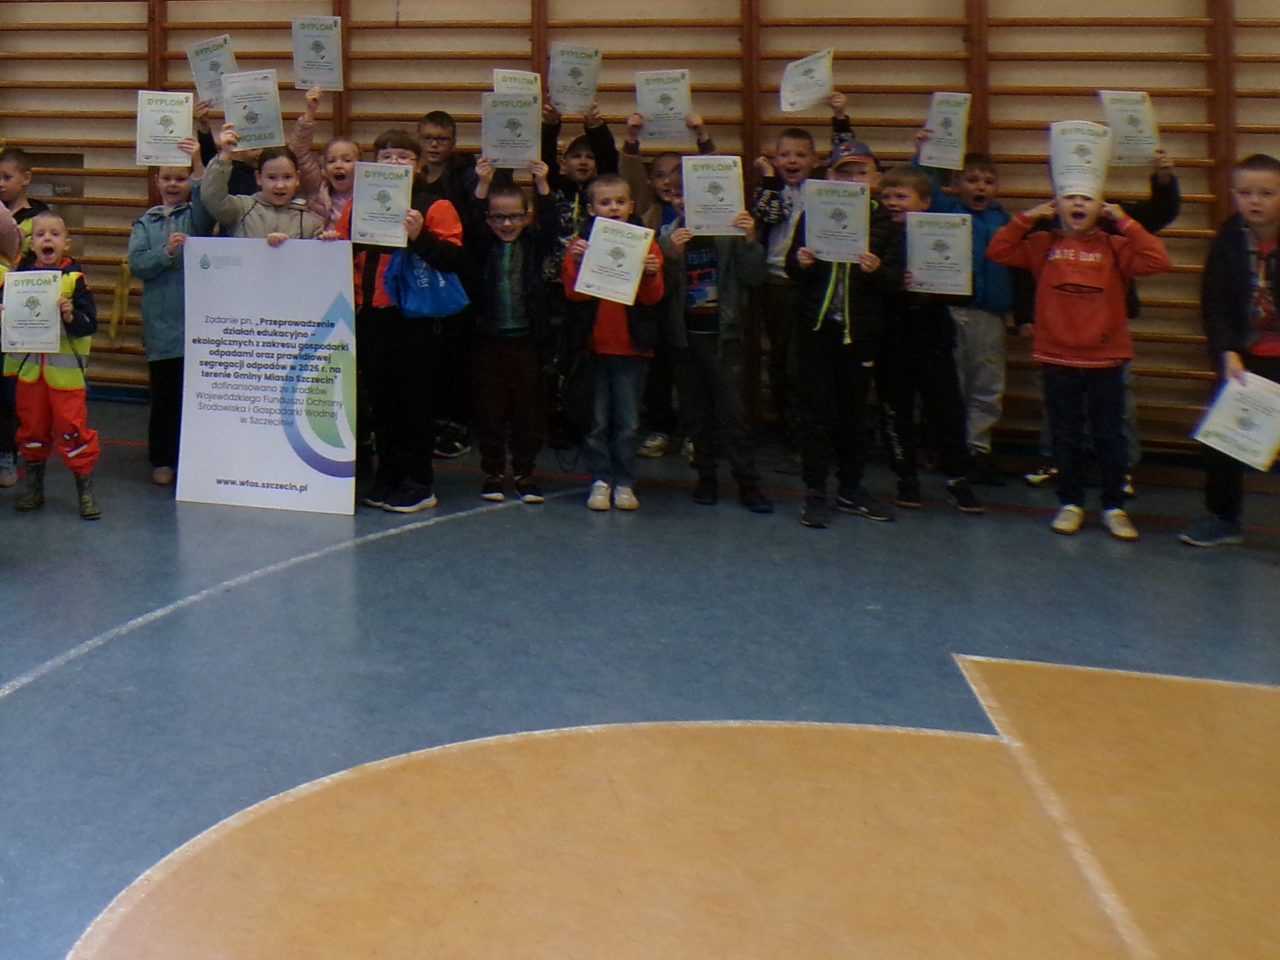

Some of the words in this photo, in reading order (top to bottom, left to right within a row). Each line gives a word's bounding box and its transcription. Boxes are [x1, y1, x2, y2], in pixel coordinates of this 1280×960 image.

[195, 42, 224, 56] DYPLOM
[148, 98, 185, 107] DYPLOM
[492, 100, 532, 108] DYPLOM
[14, 277, 52, 287] DYPLOM
[205, 315, 238, 324] Zadanie
[257, 330, 308, 340] edukacyjno
[192, 337, 254, 348] ekologicznych
[262, 340, 296, 349] zakresu
[298, 342, 349, 352] gospodarki
[209, 348, 254, 359] odpadami
[199, 359, 245, 370] segregacji
[246, 361, 288, 371] odpadów
[201, 370, 231, 379] terenie
[233, 372, 262, 382] Gminy
[264, 373, 294, 382] Miasta
[212, 381, 277, 392] dofinansowano
[252, 406, 303, 416] Gospodarki
[216, 478, 308, 493] www.wfos.szczecin.pl
